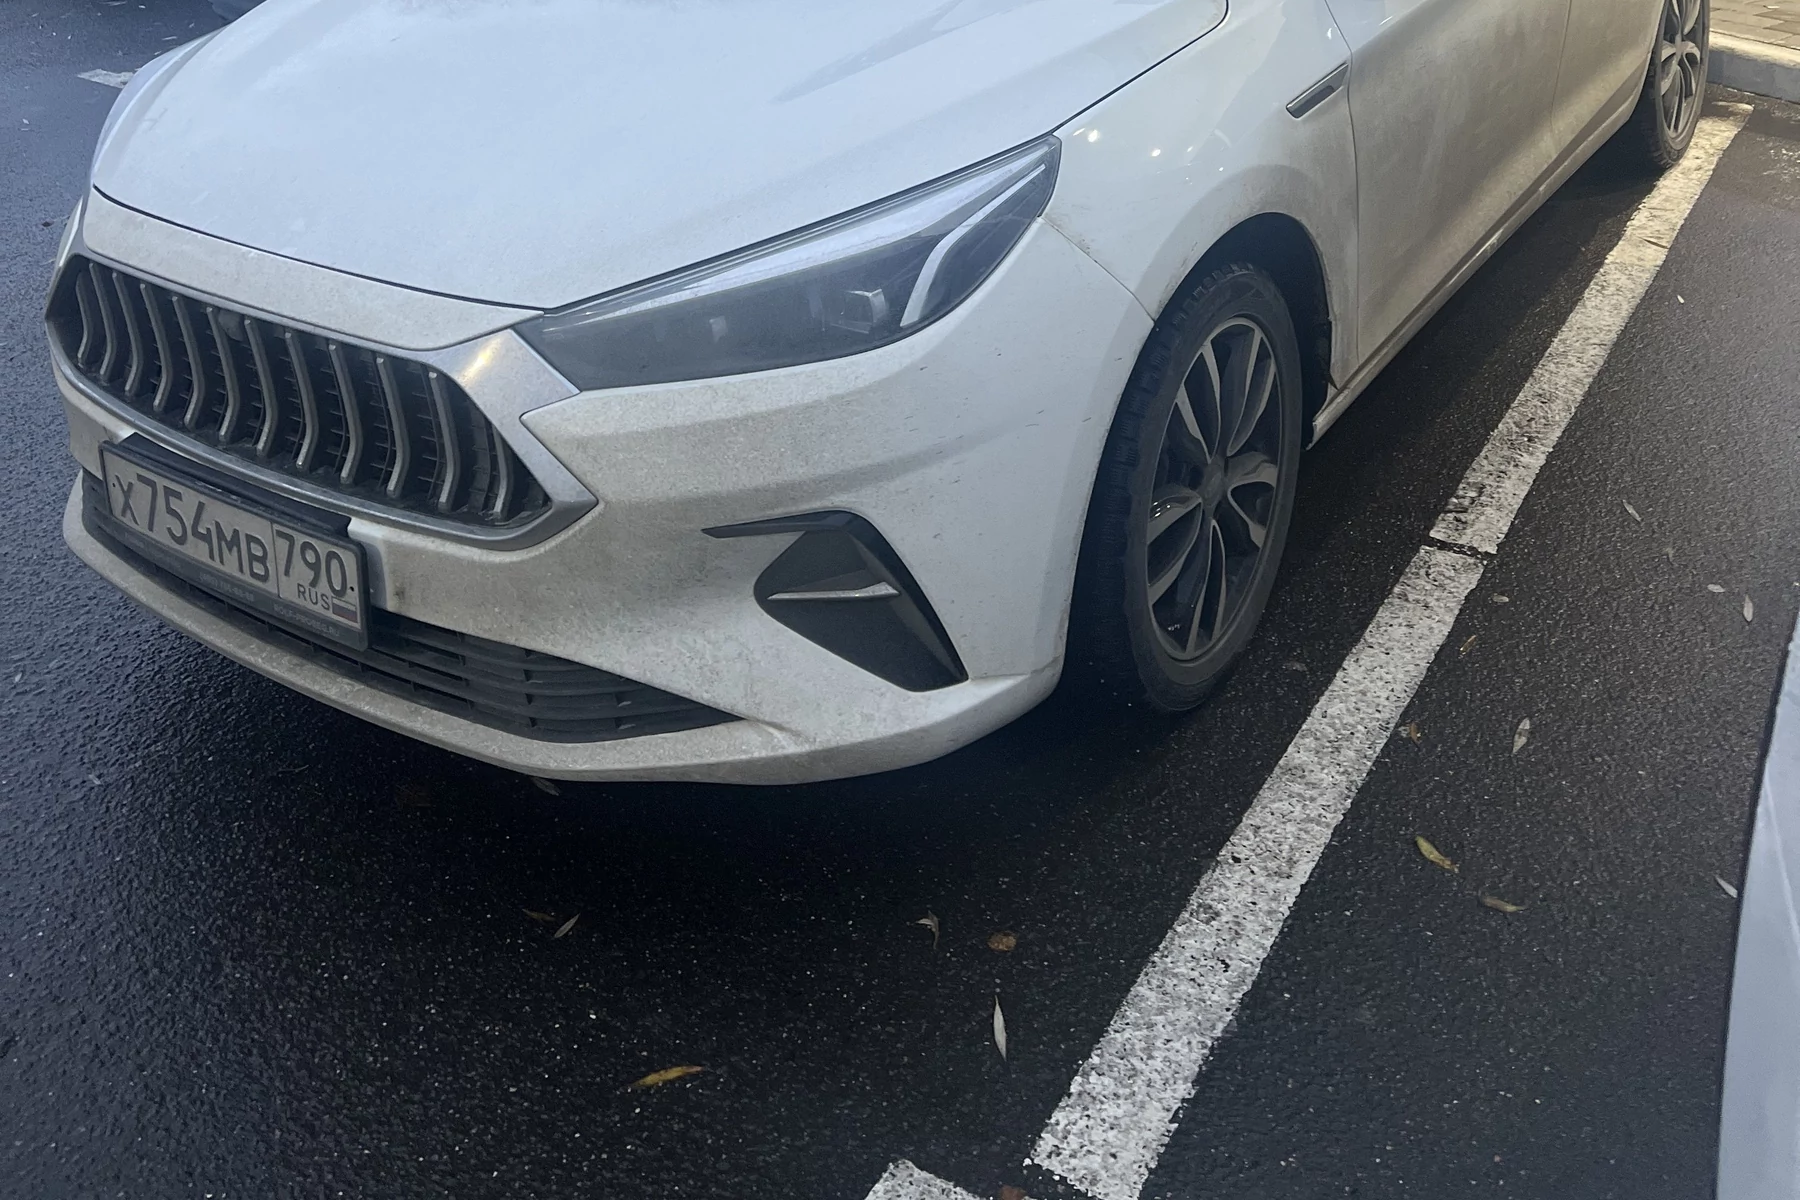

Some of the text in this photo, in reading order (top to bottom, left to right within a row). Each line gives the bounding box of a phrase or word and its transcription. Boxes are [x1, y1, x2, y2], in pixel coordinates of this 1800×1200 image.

[115, 473, 348, 597] Х754МВ 790
[296, 582, 331, 611] RUS
